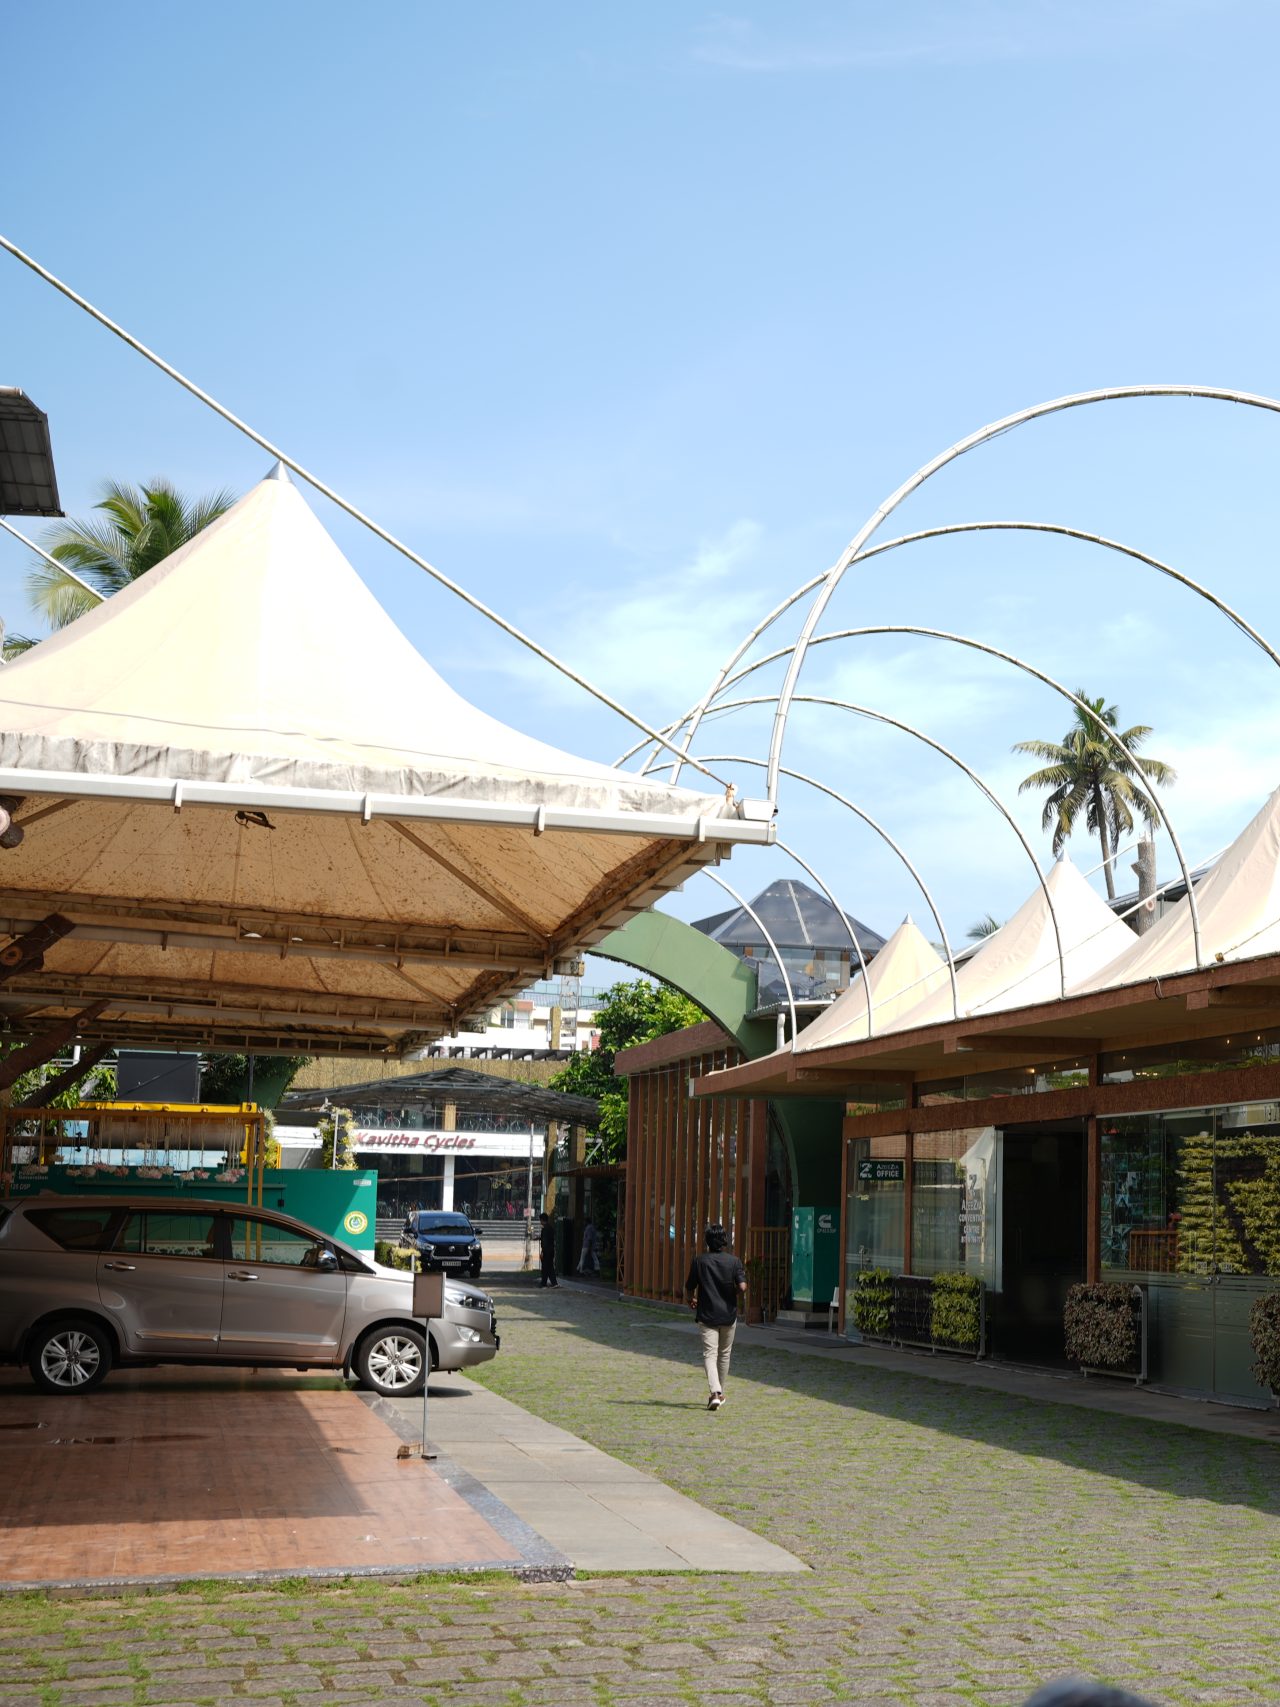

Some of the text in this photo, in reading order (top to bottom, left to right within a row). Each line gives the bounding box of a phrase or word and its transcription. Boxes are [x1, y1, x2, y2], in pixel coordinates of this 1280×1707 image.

[355, 1133, 477, 1152] Kavitha Cycles
[876, 1170, 900, 1178] OFFICE
